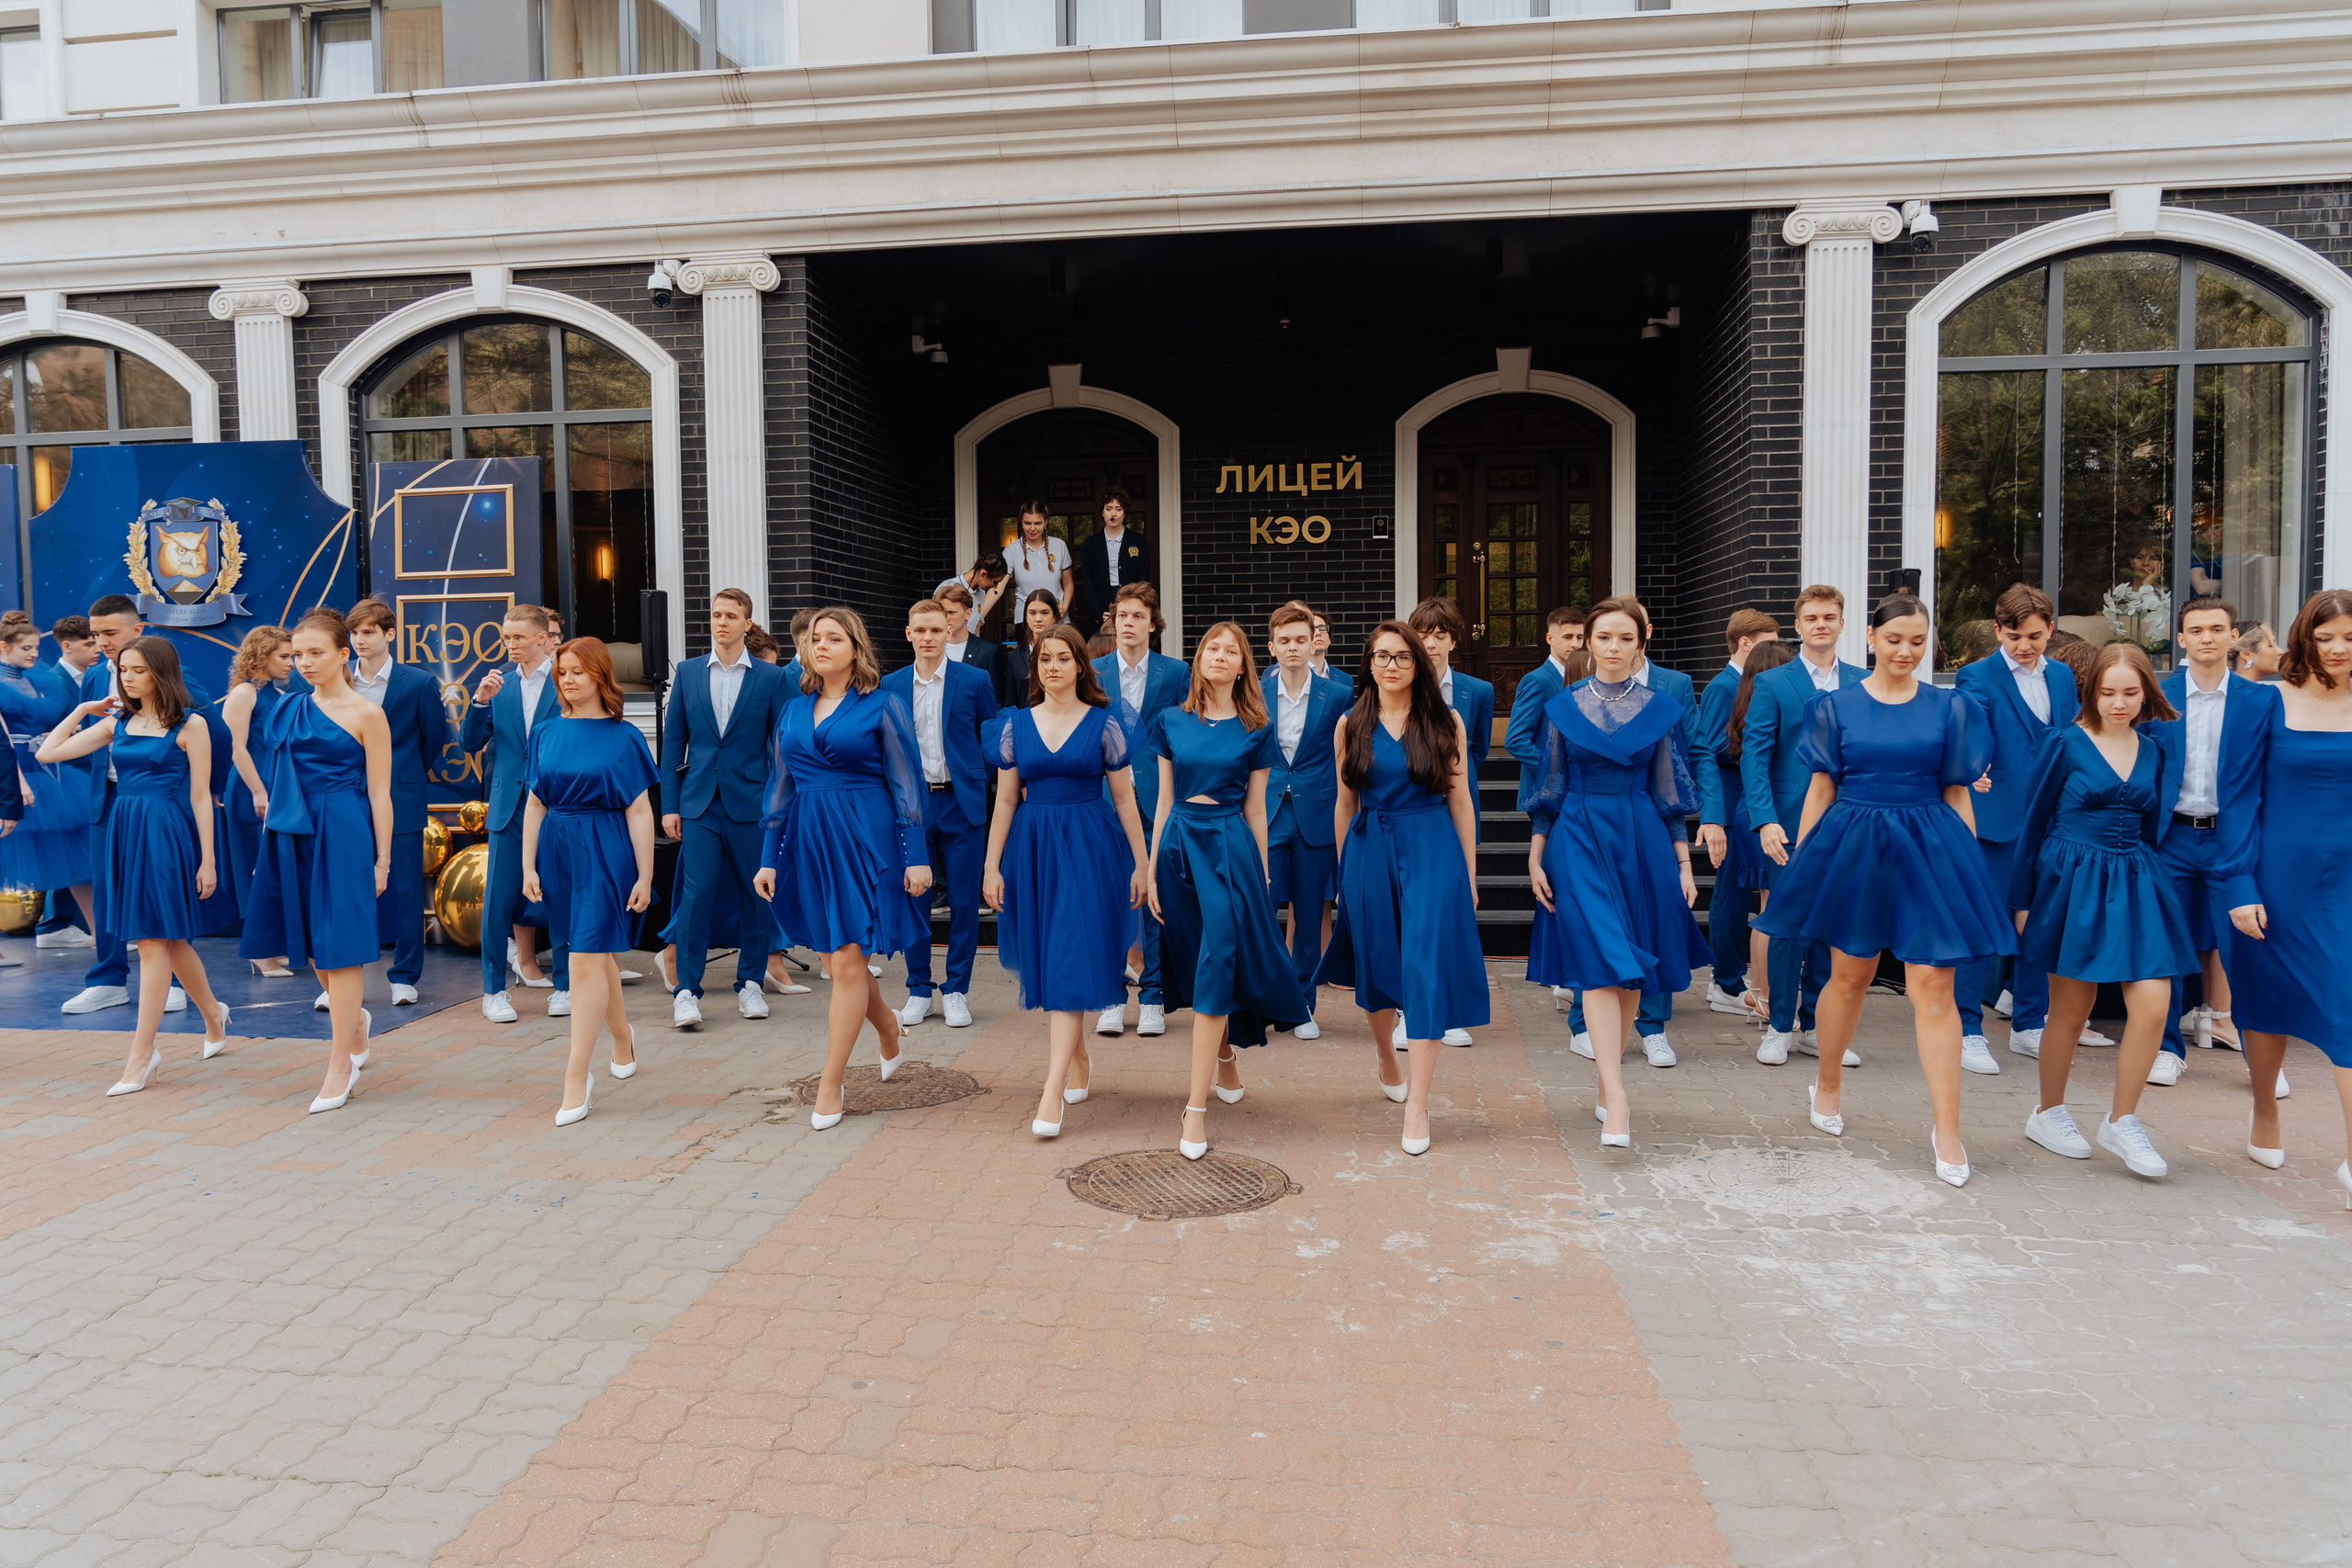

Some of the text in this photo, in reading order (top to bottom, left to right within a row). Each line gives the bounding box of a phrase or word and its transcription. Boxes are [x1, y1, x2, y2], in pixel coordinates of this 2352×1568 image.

[1216, 455, 1363, 497] ЛИЦЕЙ
[1250, 515, 1332, 545] КЭО
[405, 621, 507, 664] КЭО
